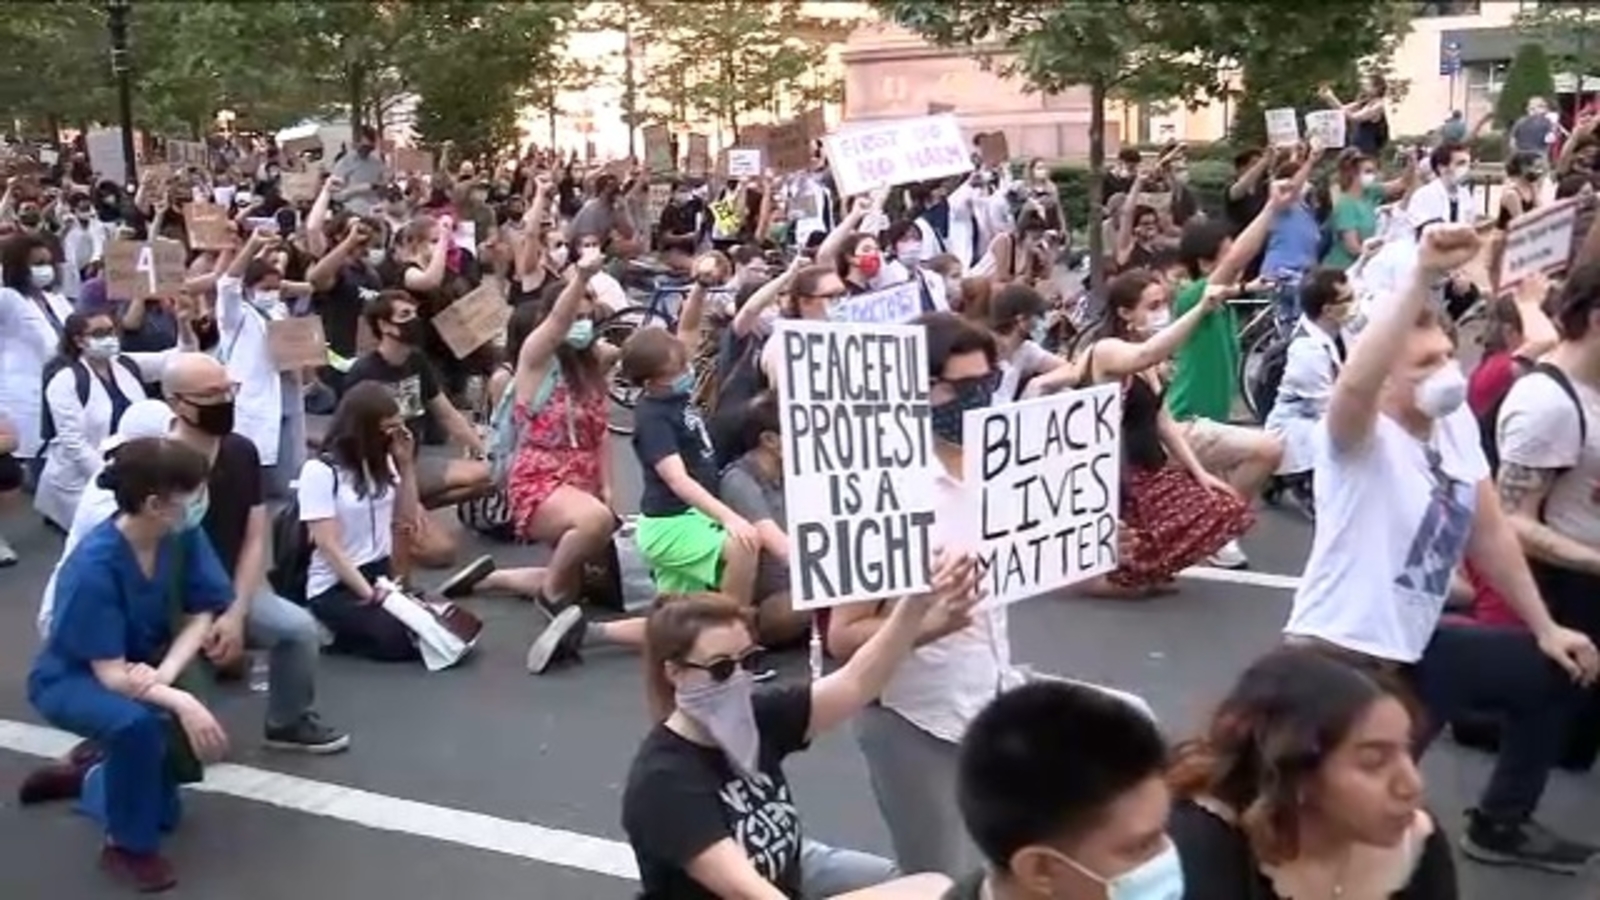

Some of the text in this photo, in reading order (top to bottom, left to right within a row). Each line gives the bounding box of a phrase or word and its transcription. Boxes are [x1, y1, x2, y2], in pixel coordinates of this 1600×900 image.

[840, 129, 899, 157] FIRST
[857, 143, 963, 182] NO HARM
[783, 331, 931, 401] PEACEFUL
[790, 404, 931, 475] PROTEST
[984, 394, 1116, 481] BLACK
[830, 471, 900, 515] IS A
[981, 453, 1112, 541] LIVES
[798, 512, 935, 601] RIGHT
[974, 513, 1117, 598] MATTER
